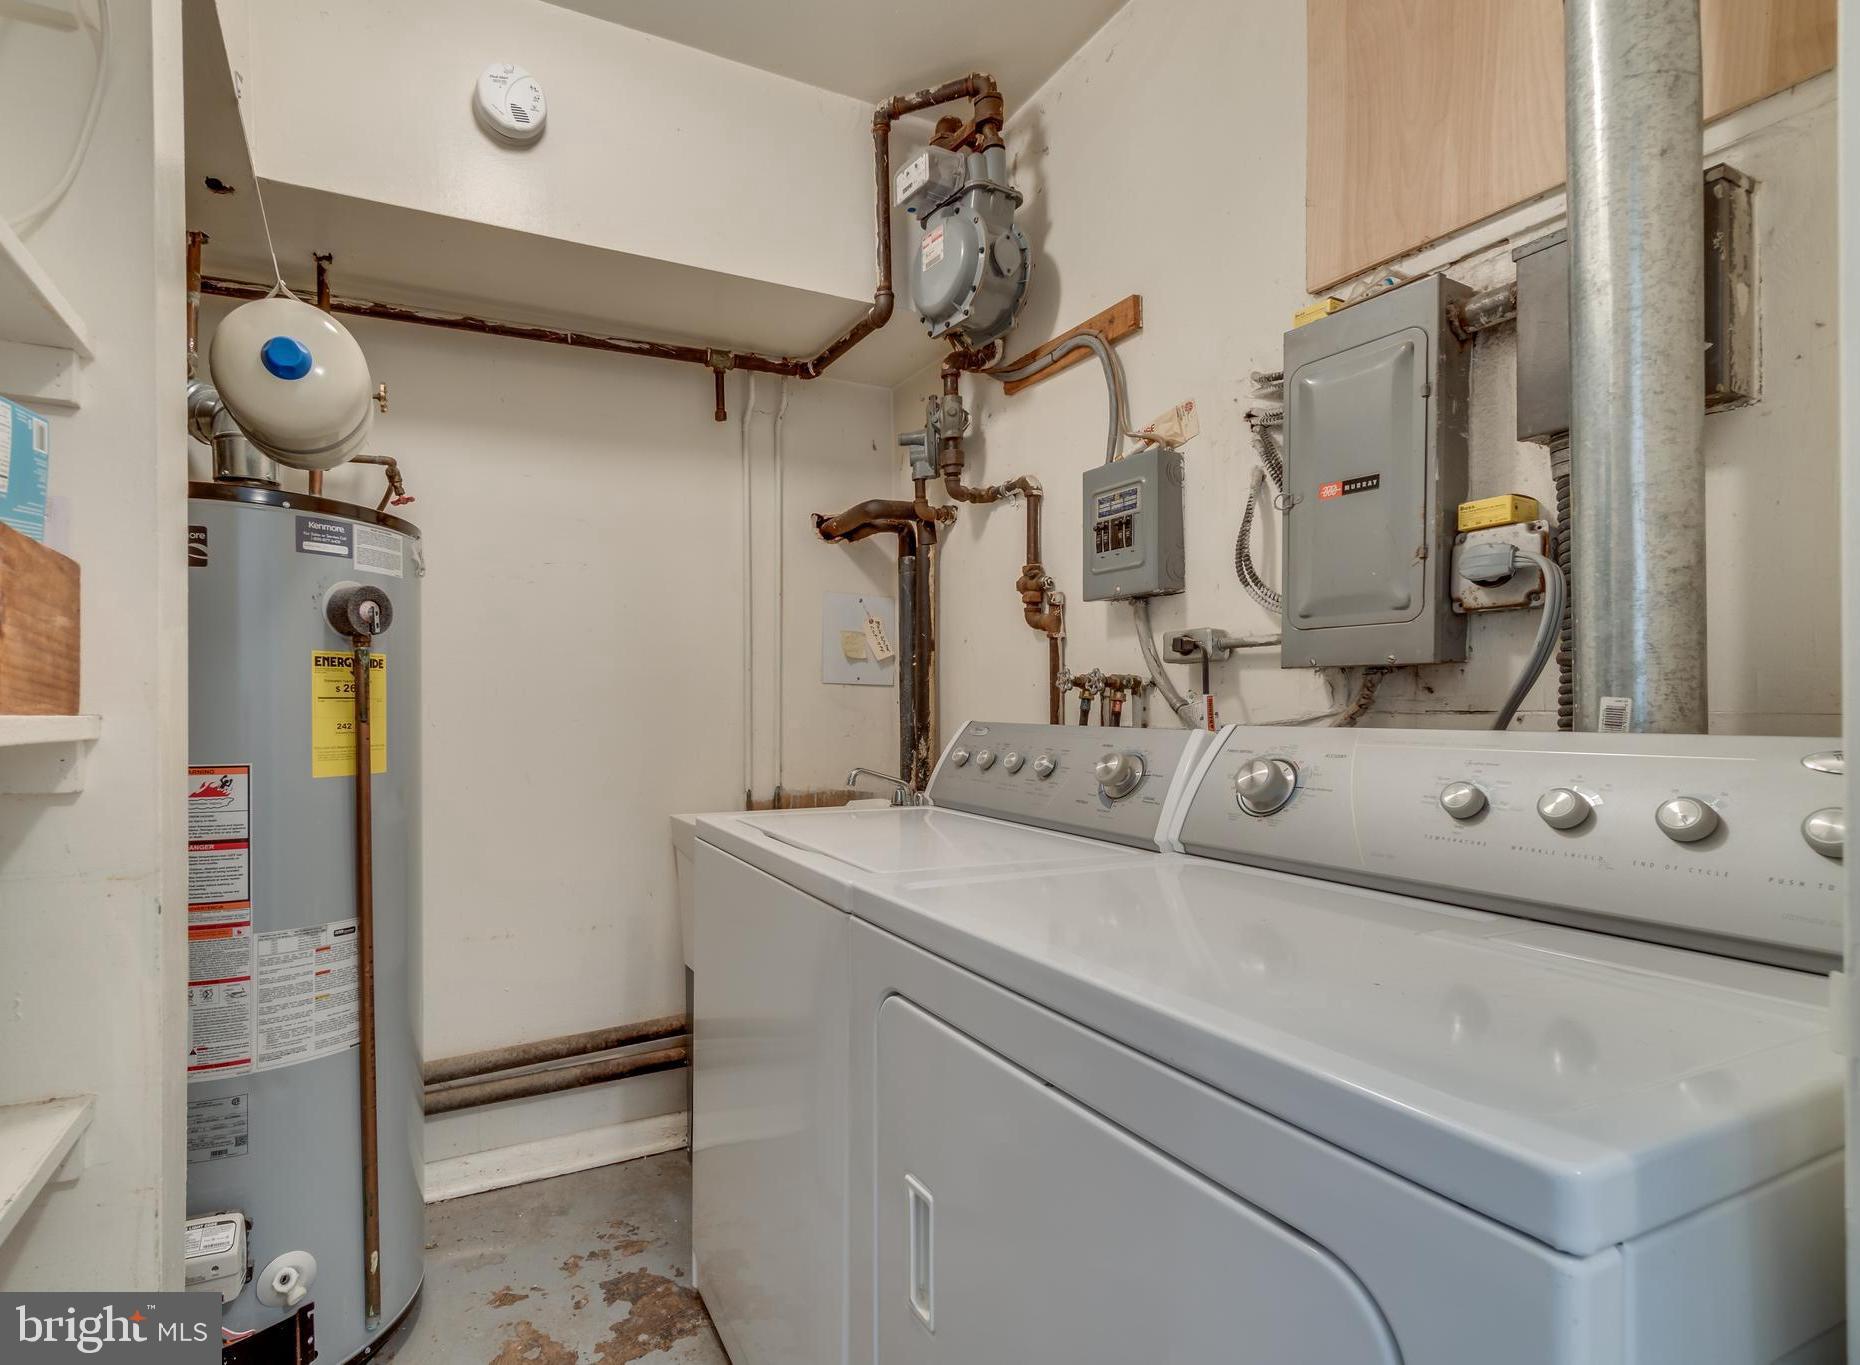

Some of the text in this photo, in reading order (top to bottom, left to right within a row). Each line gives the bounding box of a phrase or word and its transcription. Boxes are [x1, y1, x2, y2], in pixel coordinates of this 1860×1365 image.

[1344, 479, 1377, 491] MURRAY
[308, 521, 345, 534] Kenmore
[314, 656, 384, 669] ENERGYIDE
[343, 684, 356, 693] 26
[336, 722, 352, 730] 242
[1632, 860, 1730, 878] END OF CYCLE
[1768, 876, 1836, 891] PUSH TO
